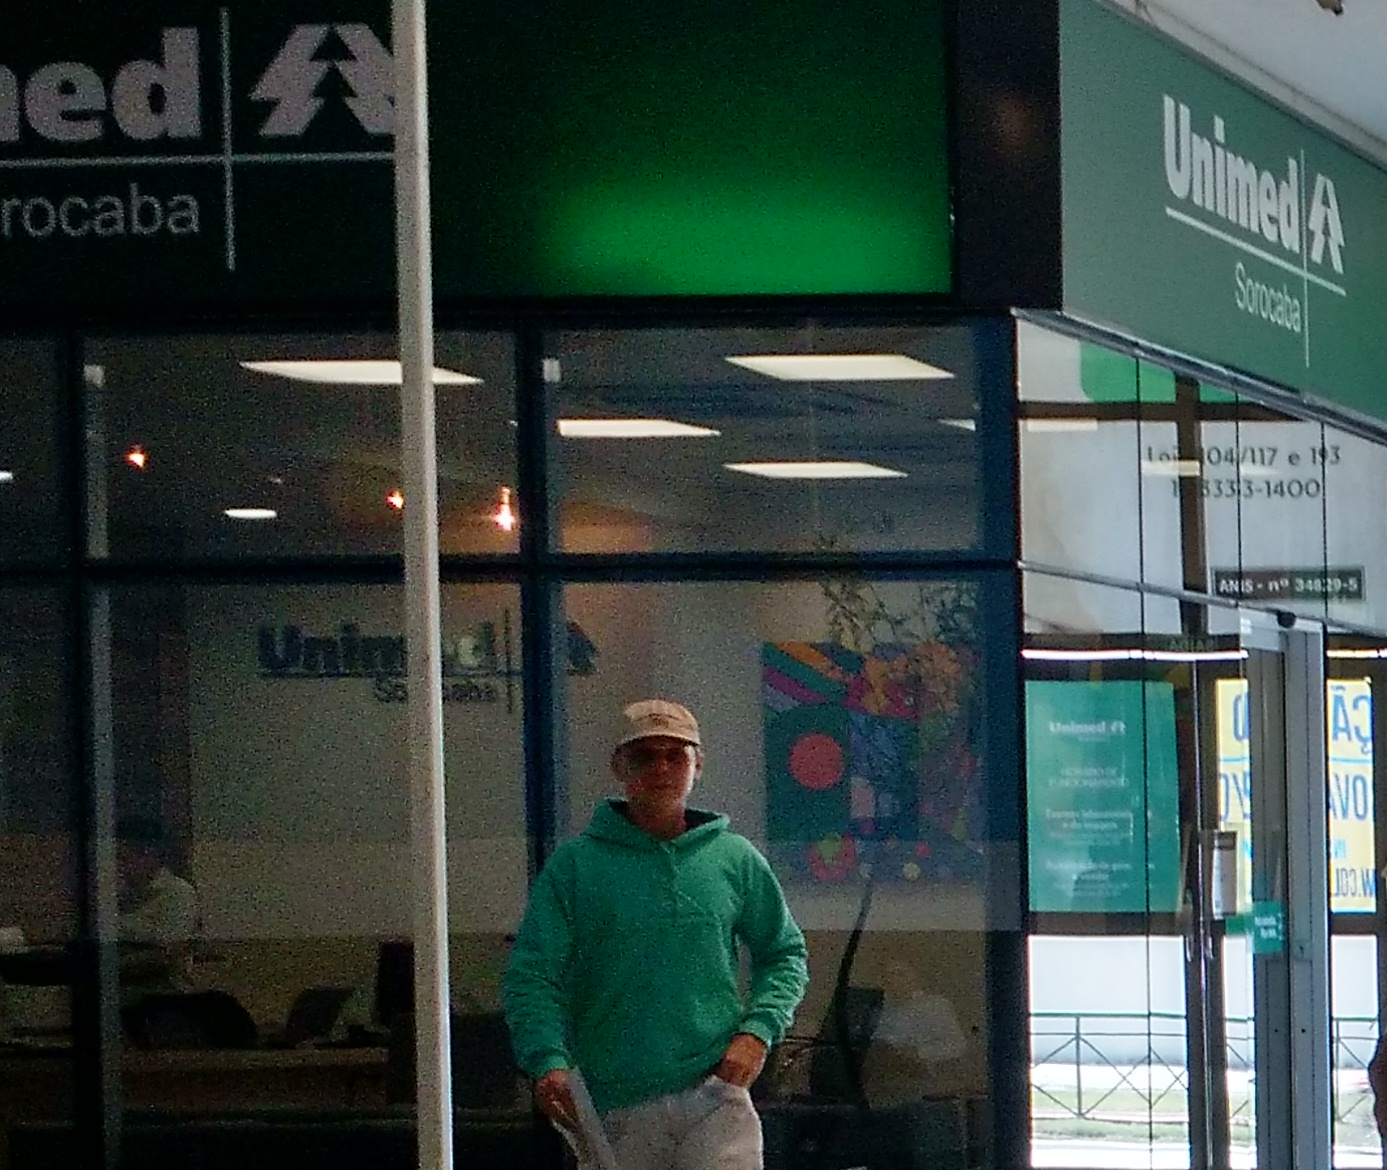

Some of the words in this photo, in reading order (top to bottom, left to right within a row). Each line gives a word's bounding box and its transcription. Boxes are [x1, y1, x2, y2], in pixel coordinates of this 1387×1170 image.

[0, 26, 202, 142] ed
[1162, 94, 1300, 254] Unimed
[1234, 262, 1302, 334] Sorocaba
[258, 622, 494, 670] Unimd
